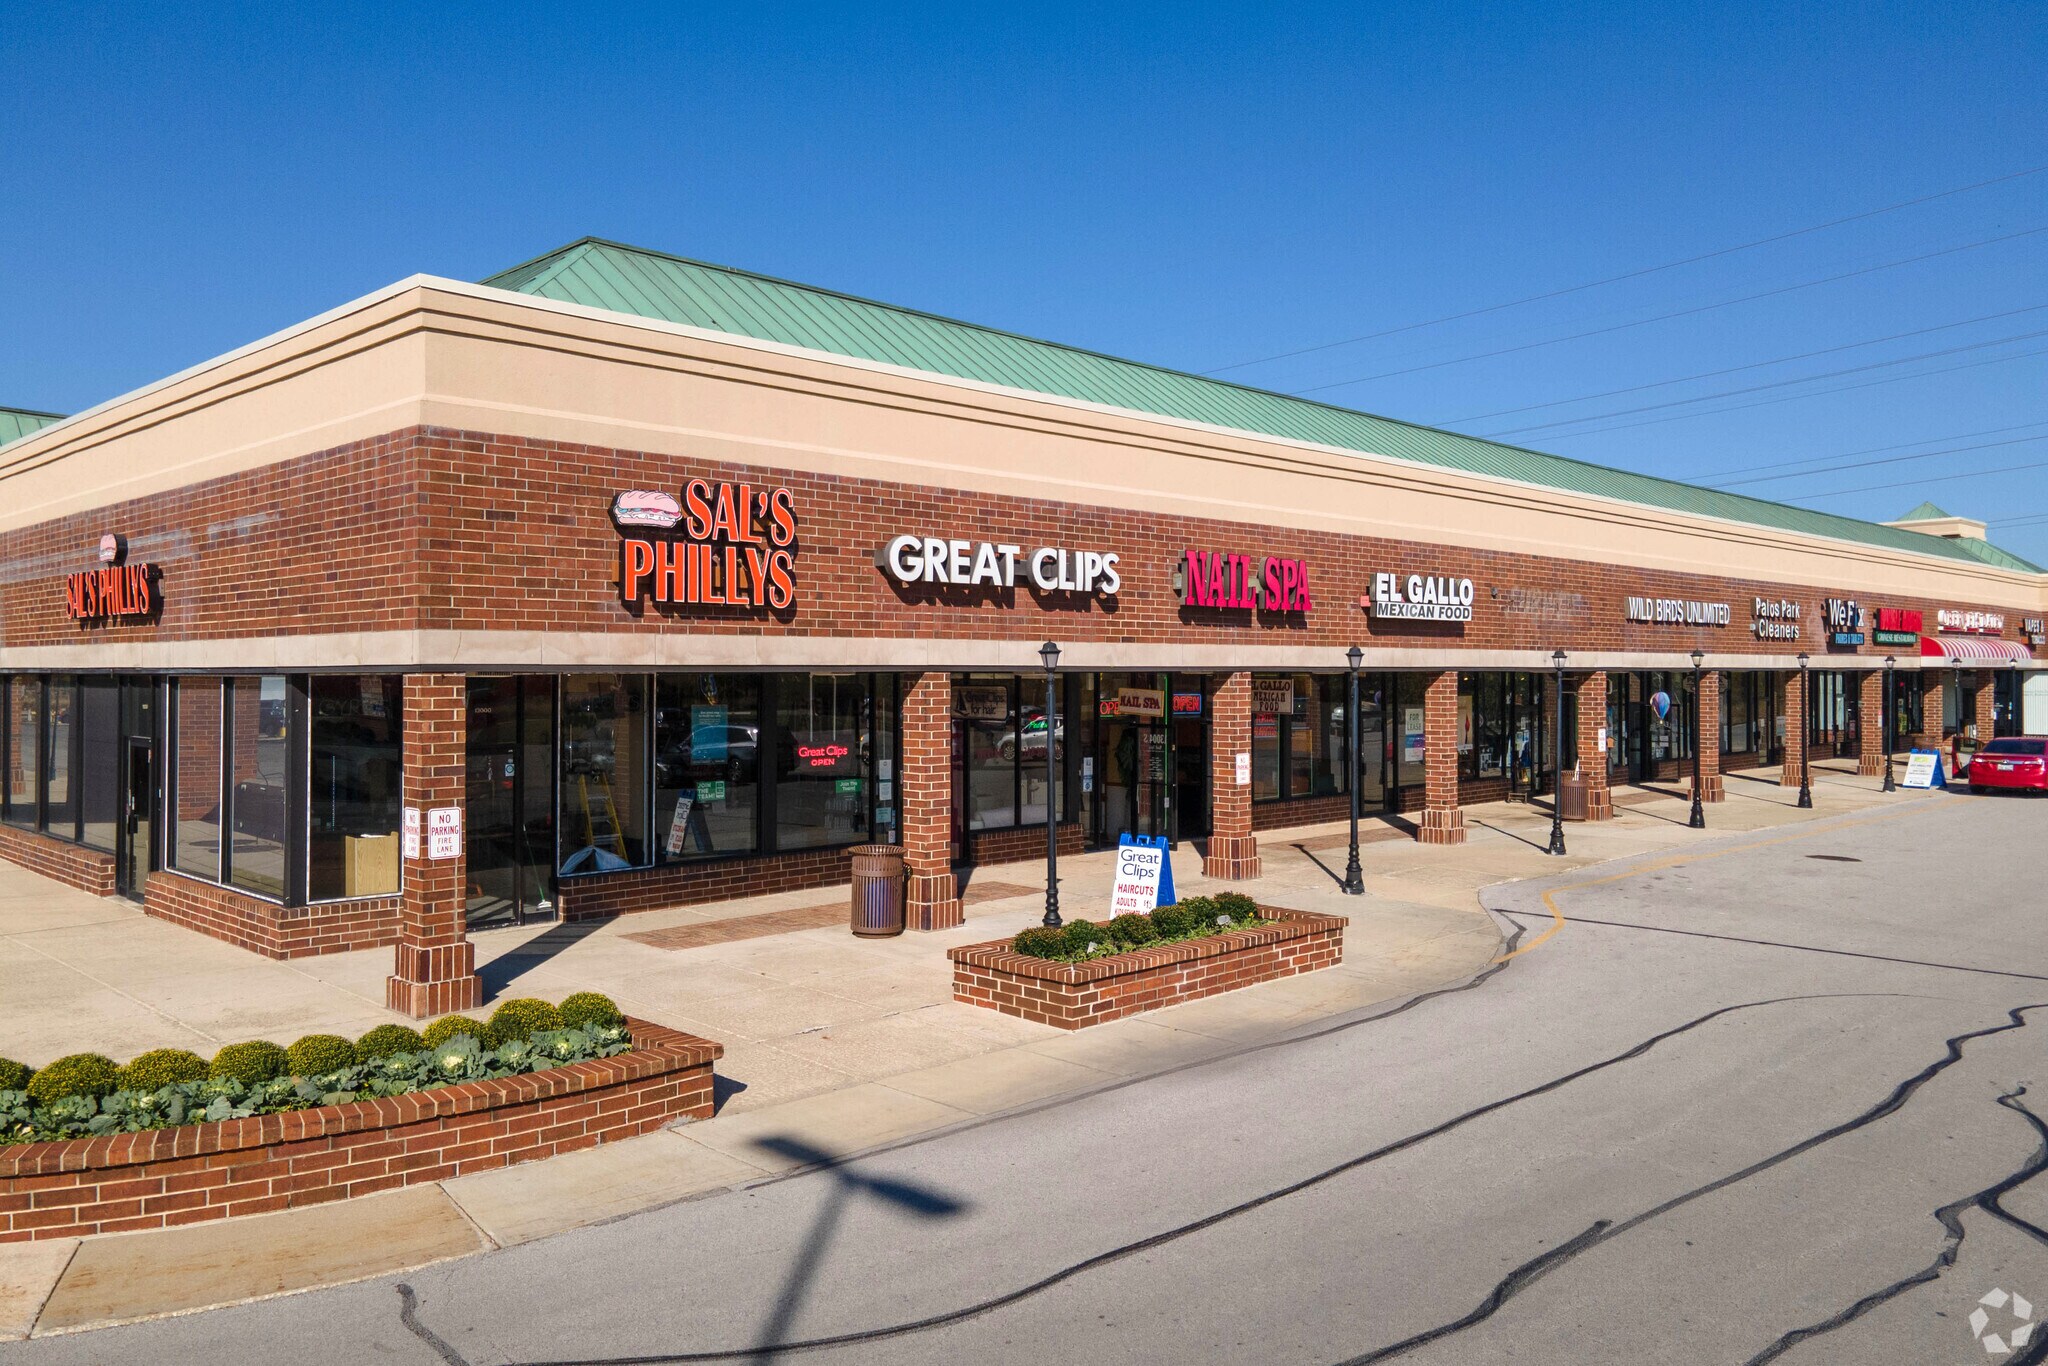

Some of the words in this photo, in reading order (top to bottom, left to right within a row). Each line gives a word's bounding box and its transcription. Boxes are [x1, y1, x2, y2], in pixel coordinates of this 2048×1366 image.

[686, 478, 795, 547] SAL'S
[888, 535, 1021, 587] GREAT
[1031, 547, 1121, 595] CLIPS
[625, 538, 794, 609] PHILLYS
[1184, 550, 1257, 609] NAIL
[1264, 556, 1313, 612] SPA
[66, 569, 97, 620] SAL'S
[98, 562, 150, 616] PHILLYS
[1376, 572, 1402, 602] EL
[1407, 574, 1474, 606] GALLO
[1377, 603, 1435, 618] MEXICAN
[1438, 606, 1470, 620] FOOD
[1628, 596, 1654, 621] WILD
[1655, 598, 1684, 623] BIRDS
[1685, 601, 1731, 625] UNLIMITED
[1755, 597, 1780, 617] Palos
[1781, 599, 1801, 619] Park
[1829, 598, 1846, 626] We
[1846, 600, 1865, 627] Fix
[1758, 618, 1800, 639] Cleaners
[1260, 680, 1291, 691] GALLO
[1120, 695, 1141, 708] NAIL
[1142, 697, 1161, 710] SPA
[1172, 695, 1200, 712] OPEN
[1253, 691, 1286, 703] MEXICAN
[1100, 701, 1120, 715] OPE
[1259, 702, 1280, 712] FOOD
[1409, 713, 1420, 721] FOR
[798, 746, 825, 757] Great
[826, 745, 848, 758] Clips
[810, 758, 835, 767] OPEN
[438, 814, 452, 824] NO
[431, 825, 459, 836] PARKING
[437, 836, 453, 845] FIRE
[436, 845, 453, 854] LANE
[1120, 848, 1160, 865] Great
[1122, 863, 1155, 881] Clips
[1117, 883, 1155, 897] HAIRCUTS
[1115, 896, 1137, 908] ADULTS
